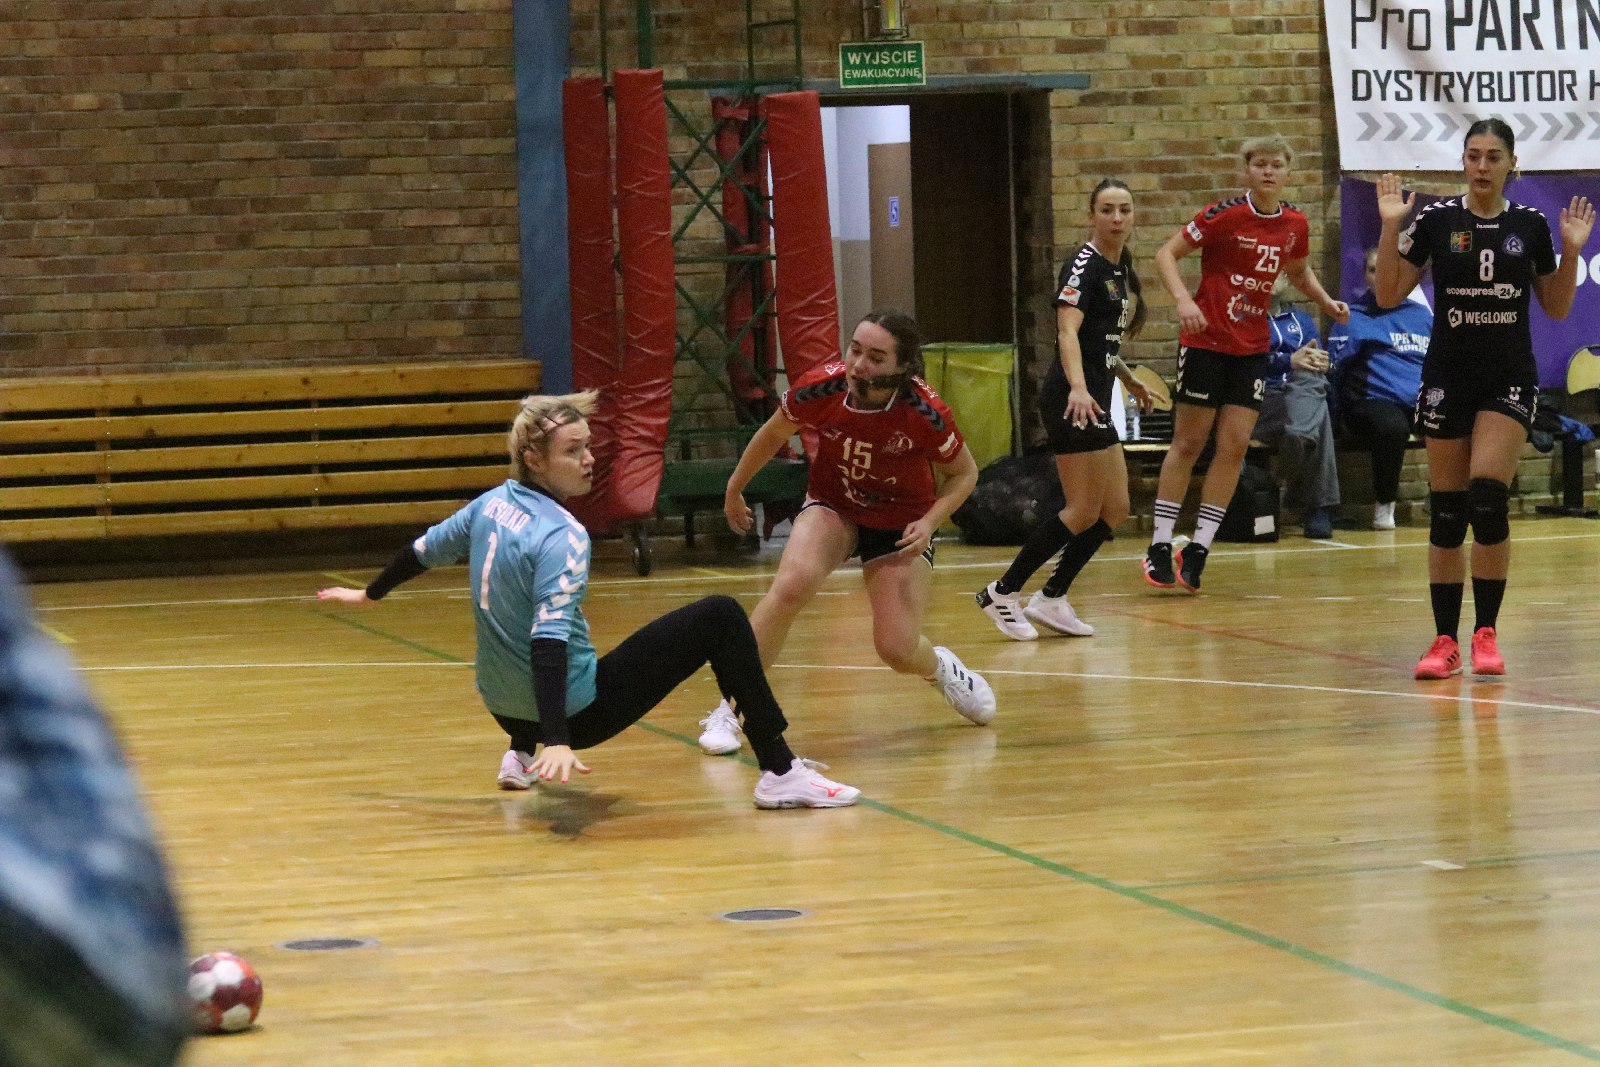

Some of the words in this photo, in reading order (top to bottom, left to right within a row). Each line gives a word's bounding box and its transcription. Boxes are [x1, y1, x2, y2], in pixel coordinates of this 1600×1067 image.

[1350, 0, 1431, 51] Pro
[844, 67, 922, 79] EWAKUACYJNE
[1351, 69, 1578, 102] DYSTRYBUTOR
[1255, 244, 1281, 273] 25
[1480, 248, 1495, 282] 8
[842, 437, 873, 469] 15
[480, 531, 498, 610] 1
